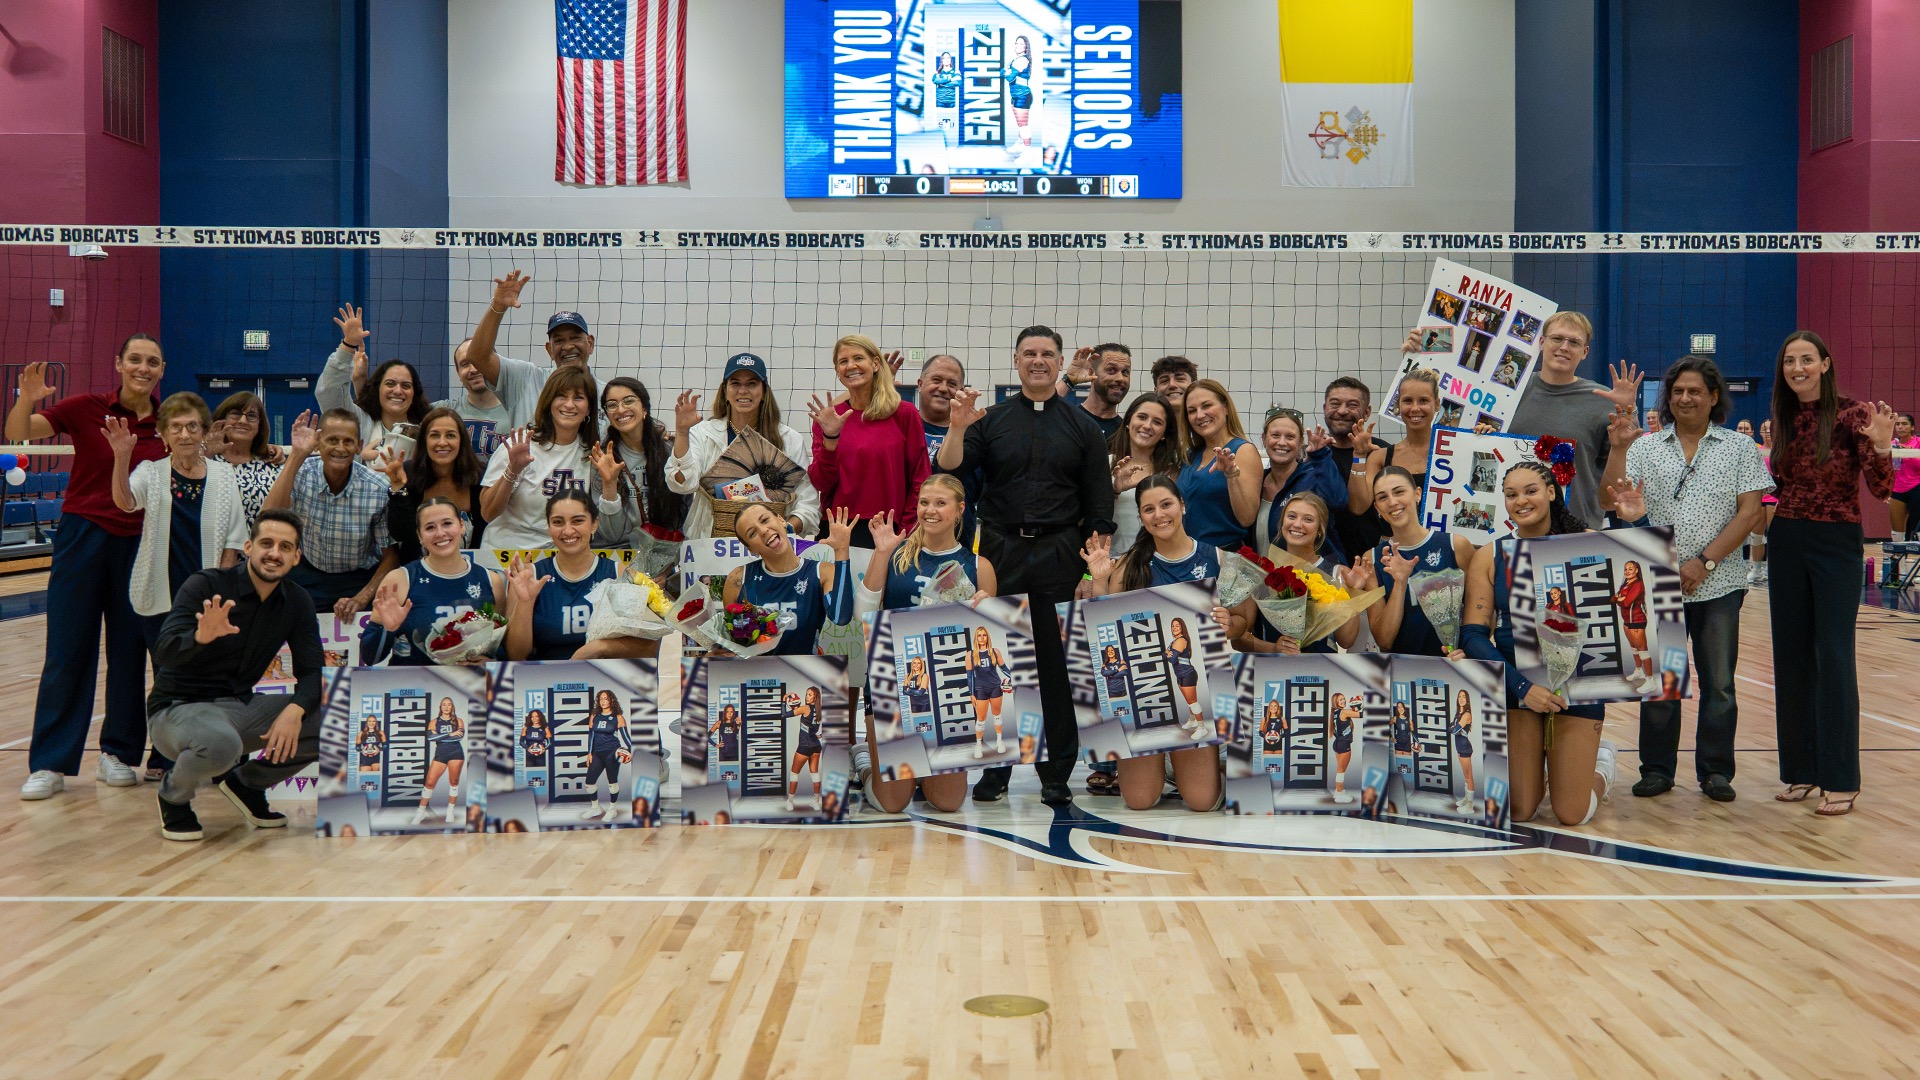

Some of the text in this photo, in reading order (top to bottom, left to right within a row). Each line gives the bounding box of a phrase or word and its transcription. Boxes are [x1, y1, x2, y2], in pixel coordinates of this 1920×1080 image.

[833, 10, 892, 164] THANK YOU
[963, 32, 1001, 141] SANCHEZ
[1073, 24, 1133, 150] SENIORS
[878, 184, 888, 194] 0
[916, 177, 931, 194] 0
[984, 180, 1017, 192] 10:51
[1037, 177, 1051, 194] 0
[1080, 184, 1090, 194] 0
[60, 227, 139, 243] BOBCATS
[301, 230, 381, 245] BOBCATS
[543, 232, 622, 246] BOBCATS
[785, 233, 865, 248] BOBCATS
[1027, 233, 1107, 248] BOBCATS
[1269, 234, 1348, 249] BOBCATS
[1508, 235, 1587, 249] BOBCATS
[1745, 235, 1823, 249] BOBCATS
[1458, 275, 1514, 312] RANYA
[1432, 368, 1497, 413] ENIOR
[1546, 566, 1564, 585] 16
[562, 604, 591, 635] 18
[1131, 613, 1145, 621] SOFIA
[1571, 563, 1618, 672] MEHTA
[905, 637, 923, 656] 31
[1123, 618, 1174, 725] SANCHEZ
[750, 679, 761, 687] ANA
[931, 633, 977, 740] BERTKE
[1269, 683, 1281, 700] 7
[1396, 683, 1407, 700] 11
[362, 697, 383, 714] 20
[528, 692, 545, 709] 18
[747, 688, 782, 790] VALENTIM DO VALE
[1289, 686, 1324, 782] COATES
[1416, 685, 1449, 789] BACHERE
[387, 697, 426, 802] NARBUTAS
[553, 691, 590, 796] BRUNO
